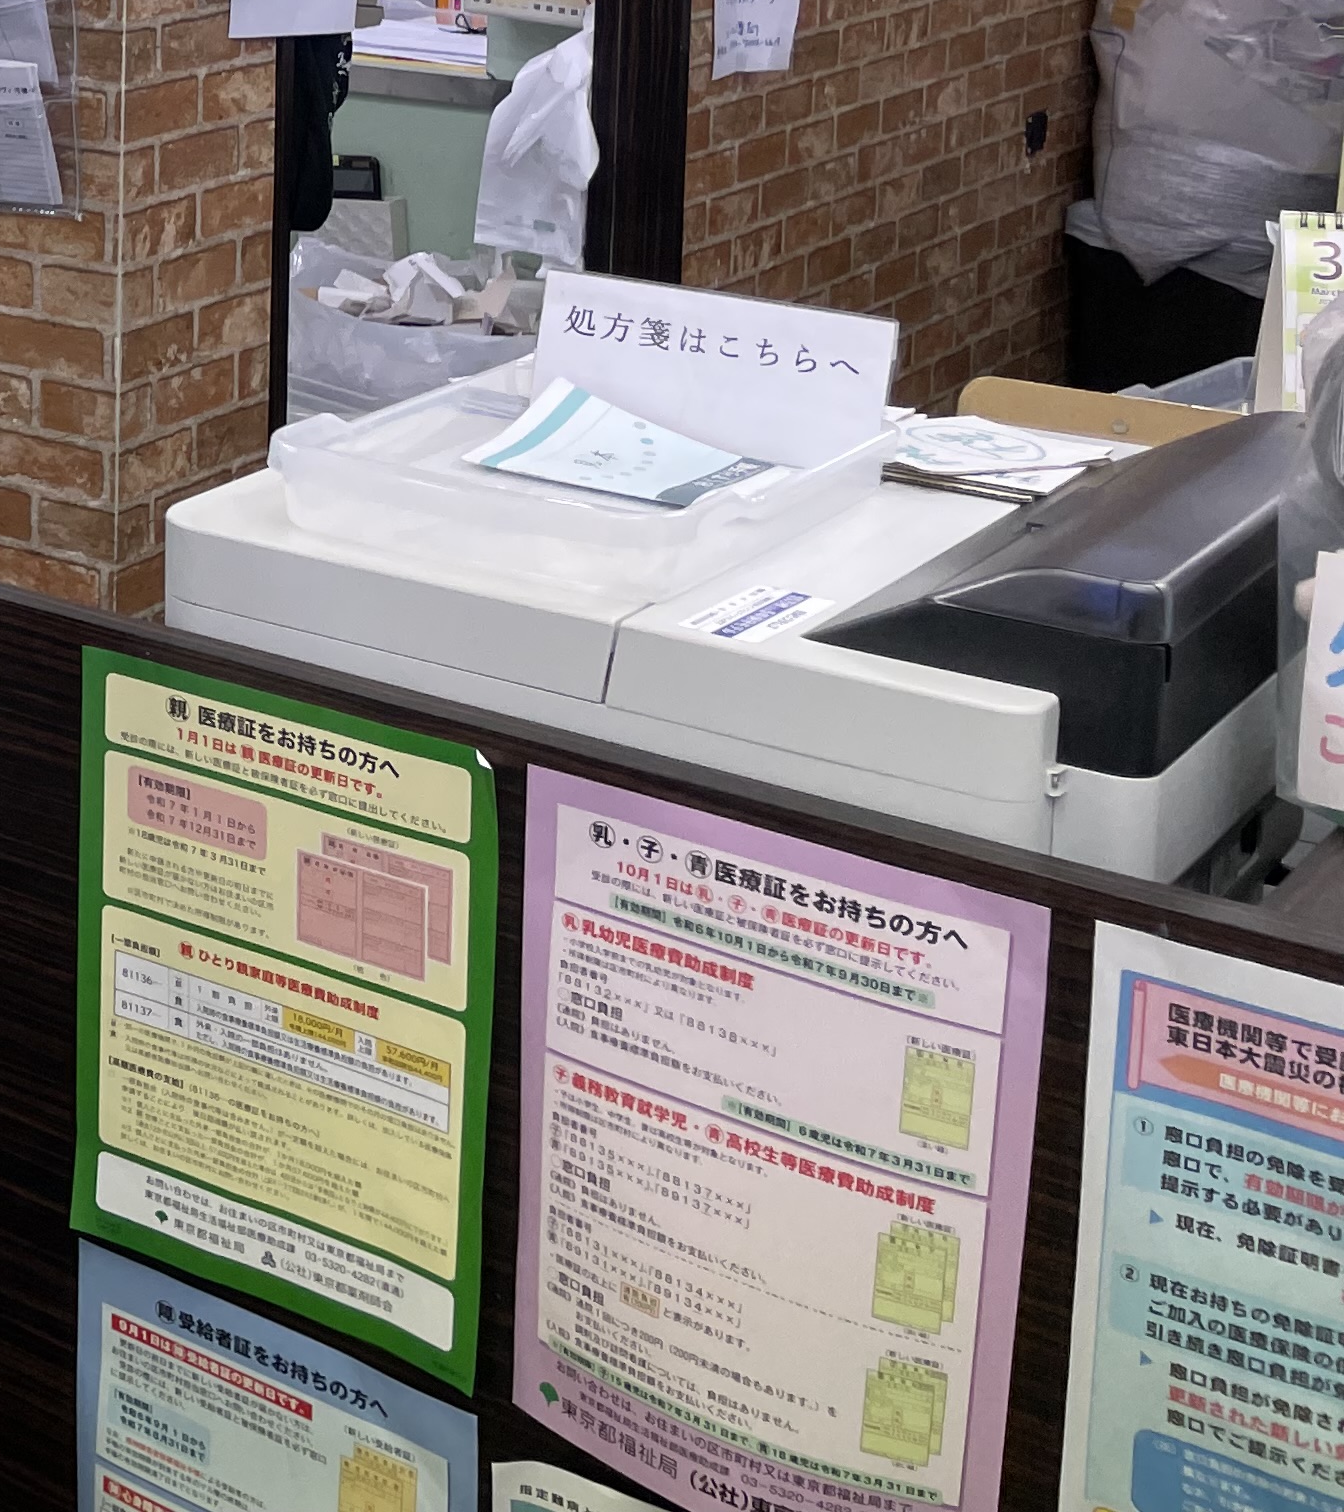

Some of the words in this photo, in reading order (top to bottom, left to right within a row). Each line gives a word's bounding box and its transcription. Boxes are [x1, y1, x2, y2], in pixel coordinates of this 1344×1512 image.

[1310, 286, 1344, 296] Marc
[565, 305, 861, 377] 処方箋はこちらへ
[1166, 1024, 1344, 1095] 東日本大震災の
[1168, 1001, 1344, 1072] 医療機関等で受
[560, 1398, 679, 1481] 東京都福祉局
